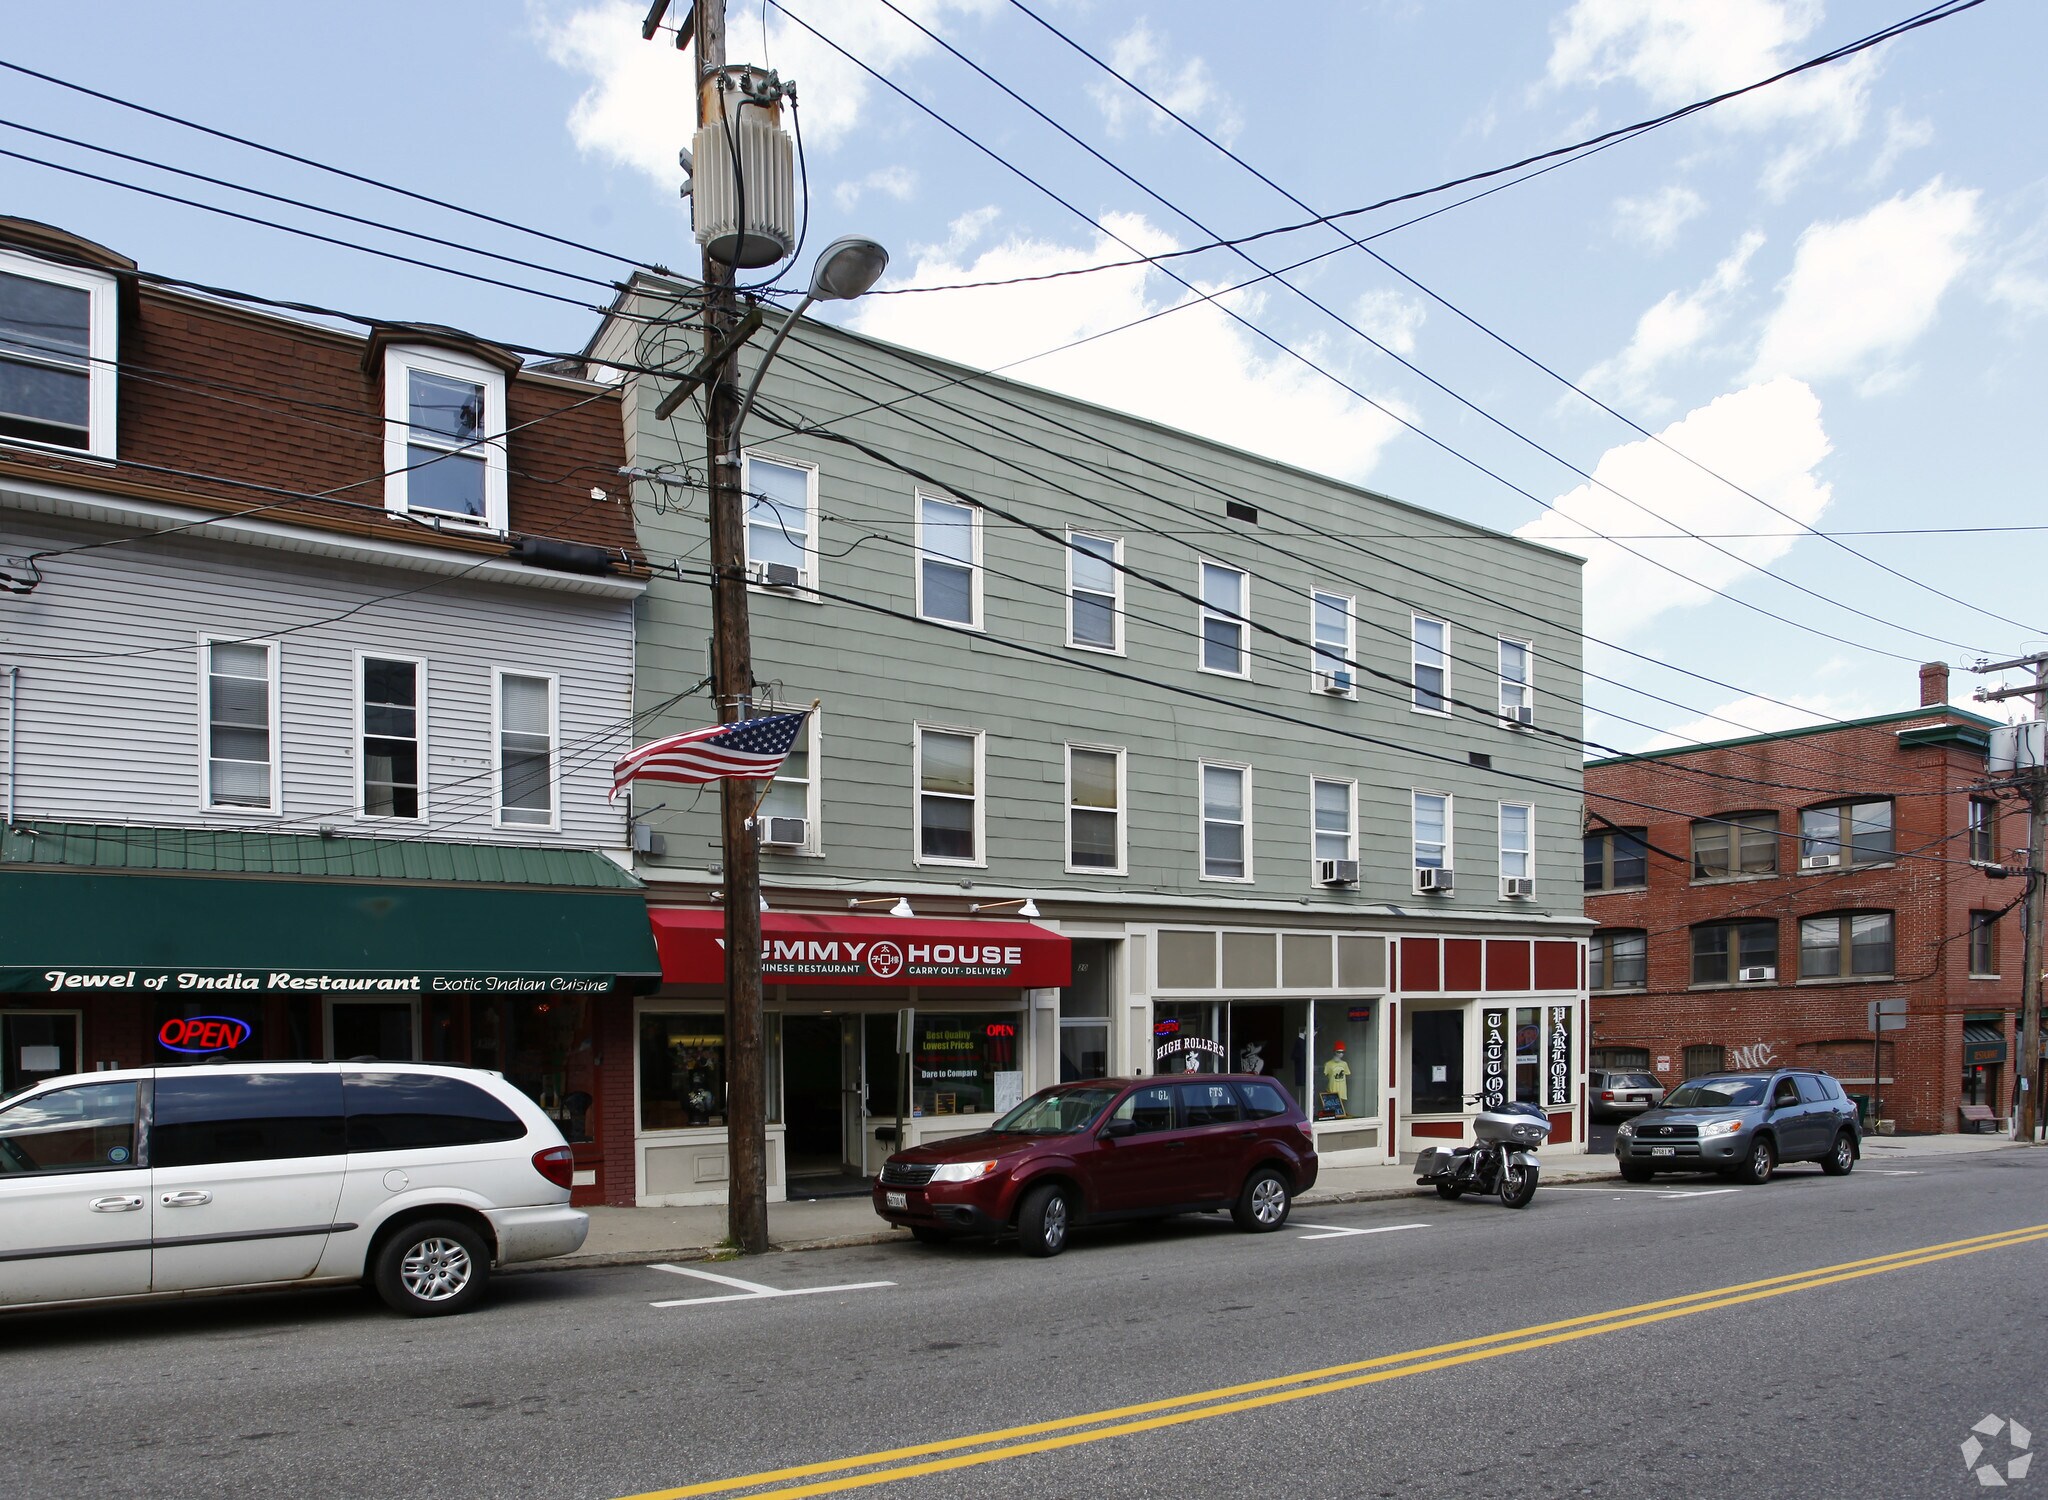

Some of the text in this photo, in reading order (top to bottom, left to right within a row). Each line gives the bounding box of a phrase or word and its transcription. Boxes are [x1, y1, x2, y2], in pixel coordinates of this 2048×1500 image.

[909, 944, 1021, 965] HOUSE
[761, 963, 860, 974] HINESE RESTAURANT
[908, 966, 1008, 976] CARRY OUT DELIVERY
[45, 971, 421, 992] Jewel of India Restaurant
[432, 976, 608, 992] Exotic Indian Cuisine
[160, 1018, 242, 1049] OPEN
[987, 1024, 1014, 1036] OPEN
[1154, 1023, 1179, 1032] OPEN
[926, 1031, 971, 1041] Best Quality
[923, 1041, 974, 1050] Lowest Prices
[1157, 1037, 1225, 1060] HIGH ROLLERS
[1485, 1013, 1504, 1108] TATTOO
[1551, 1006, 1568, 1103] PARLOUR
[921, 1069, 978, 1079] Dare to Compare
